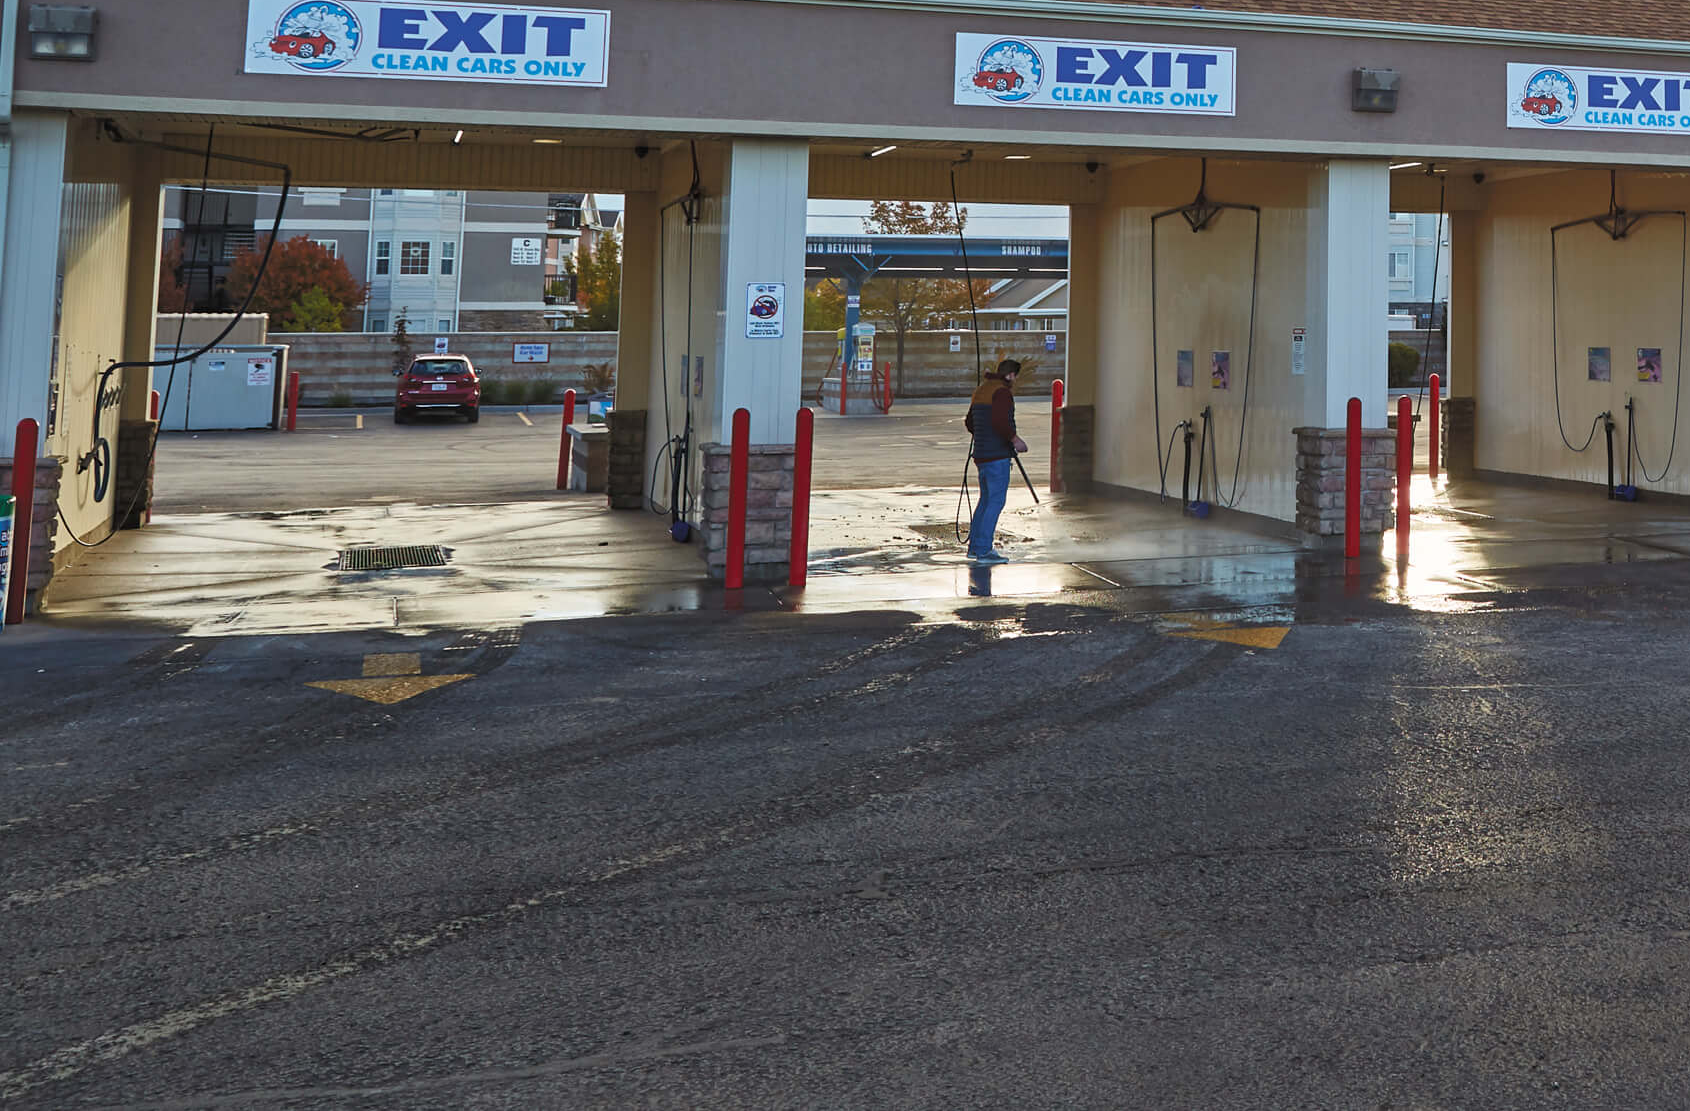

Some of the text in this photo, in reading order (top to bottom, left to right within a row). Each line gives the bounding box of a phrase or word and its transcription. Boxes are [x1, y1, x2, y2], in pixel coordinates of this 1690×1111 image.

[377, 7, 587, 58] EXIT
[371, 53, 587, 78] CLEAN CARS ONLY
[1055, 46, 1218, 90] EXIT
[1051, 86, 1219, 108] CLEAN CARS ONLY
[1584, 111, 1633, 126] CLEAN
[1637, 114, 1676, 128] CARS
[523, 239, 531, 247] C
[807, 243, 873, 254] UTO DETAILING
[1001, 245, 1042, 256] SHAMPOO
